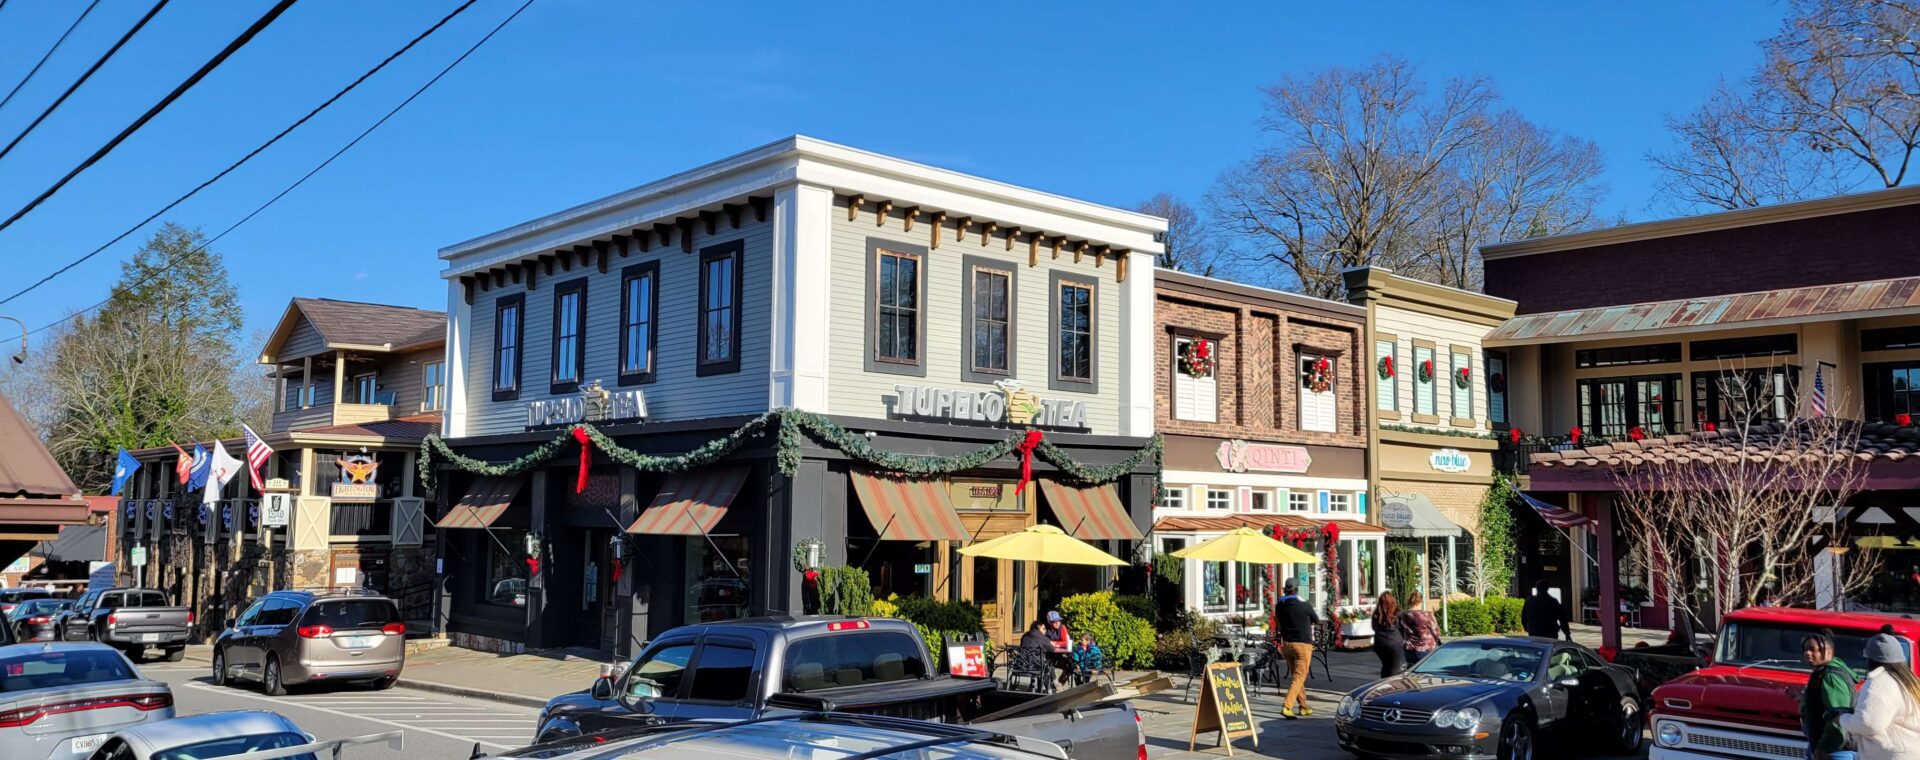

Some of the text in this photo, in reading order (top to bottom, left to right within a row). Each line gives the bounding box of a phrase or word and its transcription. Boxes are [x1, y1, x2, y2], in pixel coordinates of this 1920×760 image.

[528, 390, 648, 426] TUPELO TEA
[893, 384, 1087, 427] TUPELO TEA
[1253, 448, 1297, 466] QINTI
[1452, 454, 1467, 466] blue
[916, 564, 929, 572] OPEN
